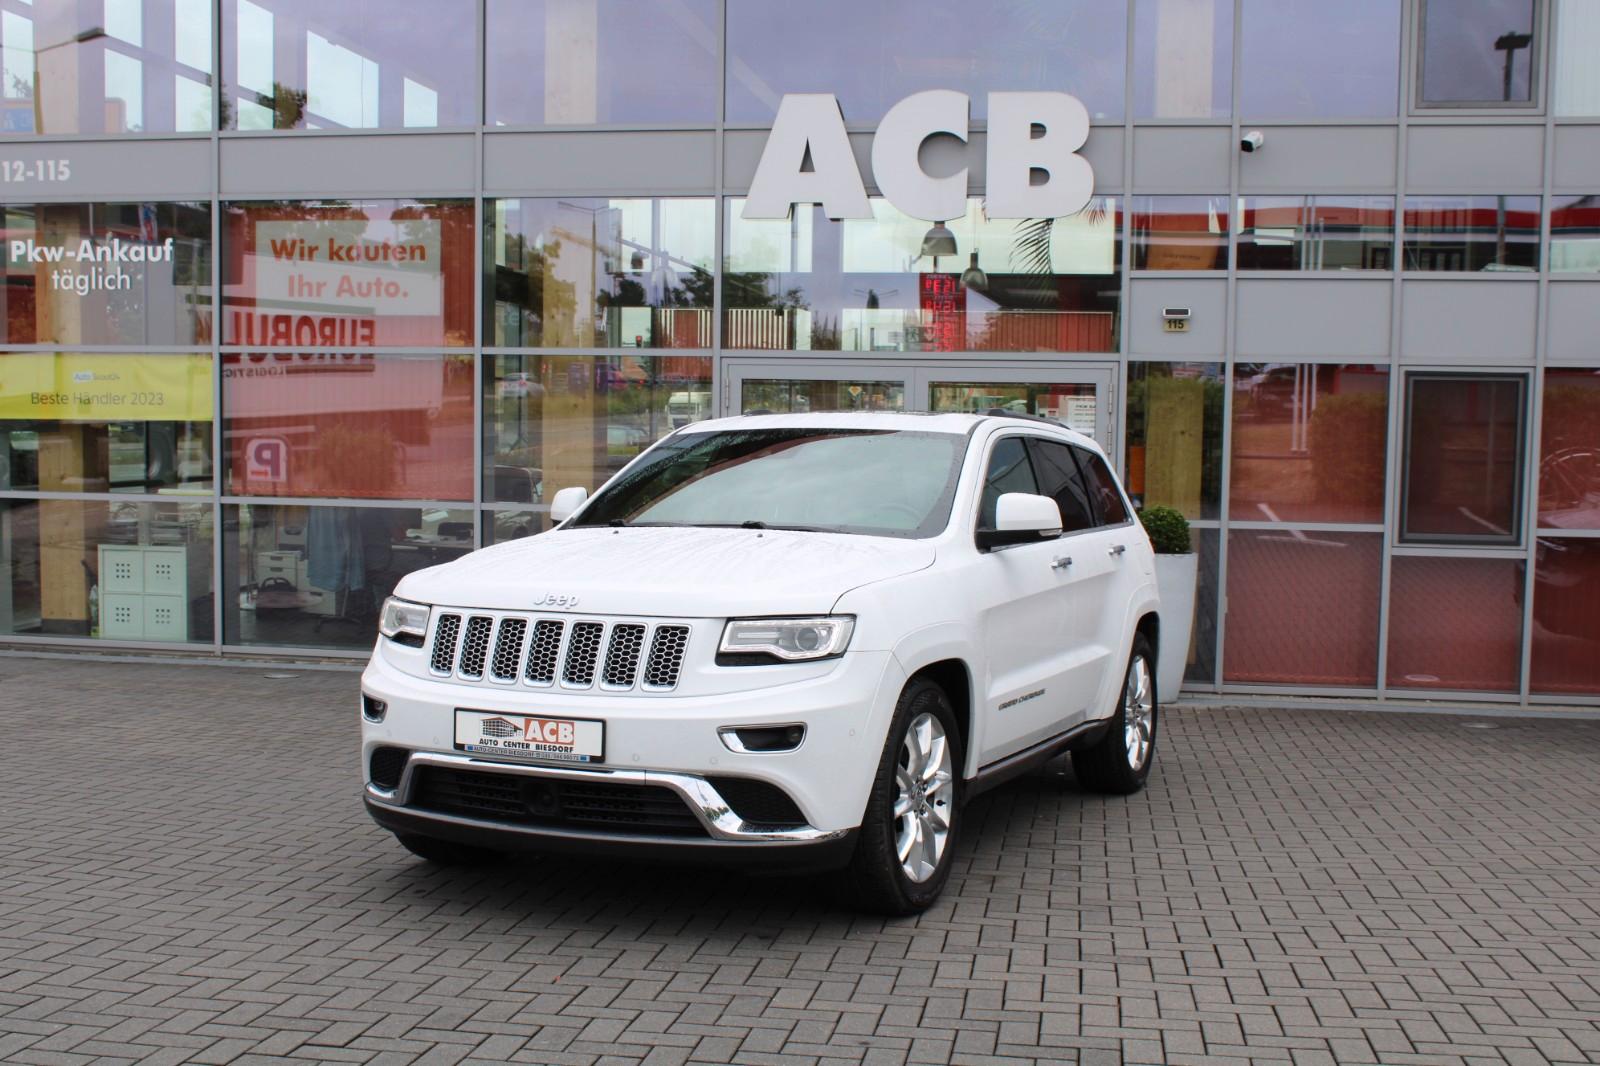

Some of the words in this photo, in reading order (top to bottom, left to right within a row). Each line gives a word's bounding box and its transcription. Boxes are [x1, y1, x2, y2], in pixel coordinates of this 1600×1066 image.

[740, 89, 1095, 222] ACB
[2, 160, 71, 182] 12-115
[10, 238, 174, 263] Pkw-Ankauf
[270, 239, 319, 262] Wir
[52, 266, 131, 296] täglich
[287, 271, 328, 298] Ihr
[335, 274, 409, 299] Auto.
[1167, 319, 1185, 330] 115
[31, 392, 69, 406] Beste
[73, 391, 127, 406] Händler
[130, 392, 164, 406] 2023
[533, 591, 579, 610] Jeep
[525, 720, 574, 744] ACB
[479, 738, 499, 747] AUTO
[503, 741, 531, 750] CENTER
[535, 744, 574, 753] BIESDORF
